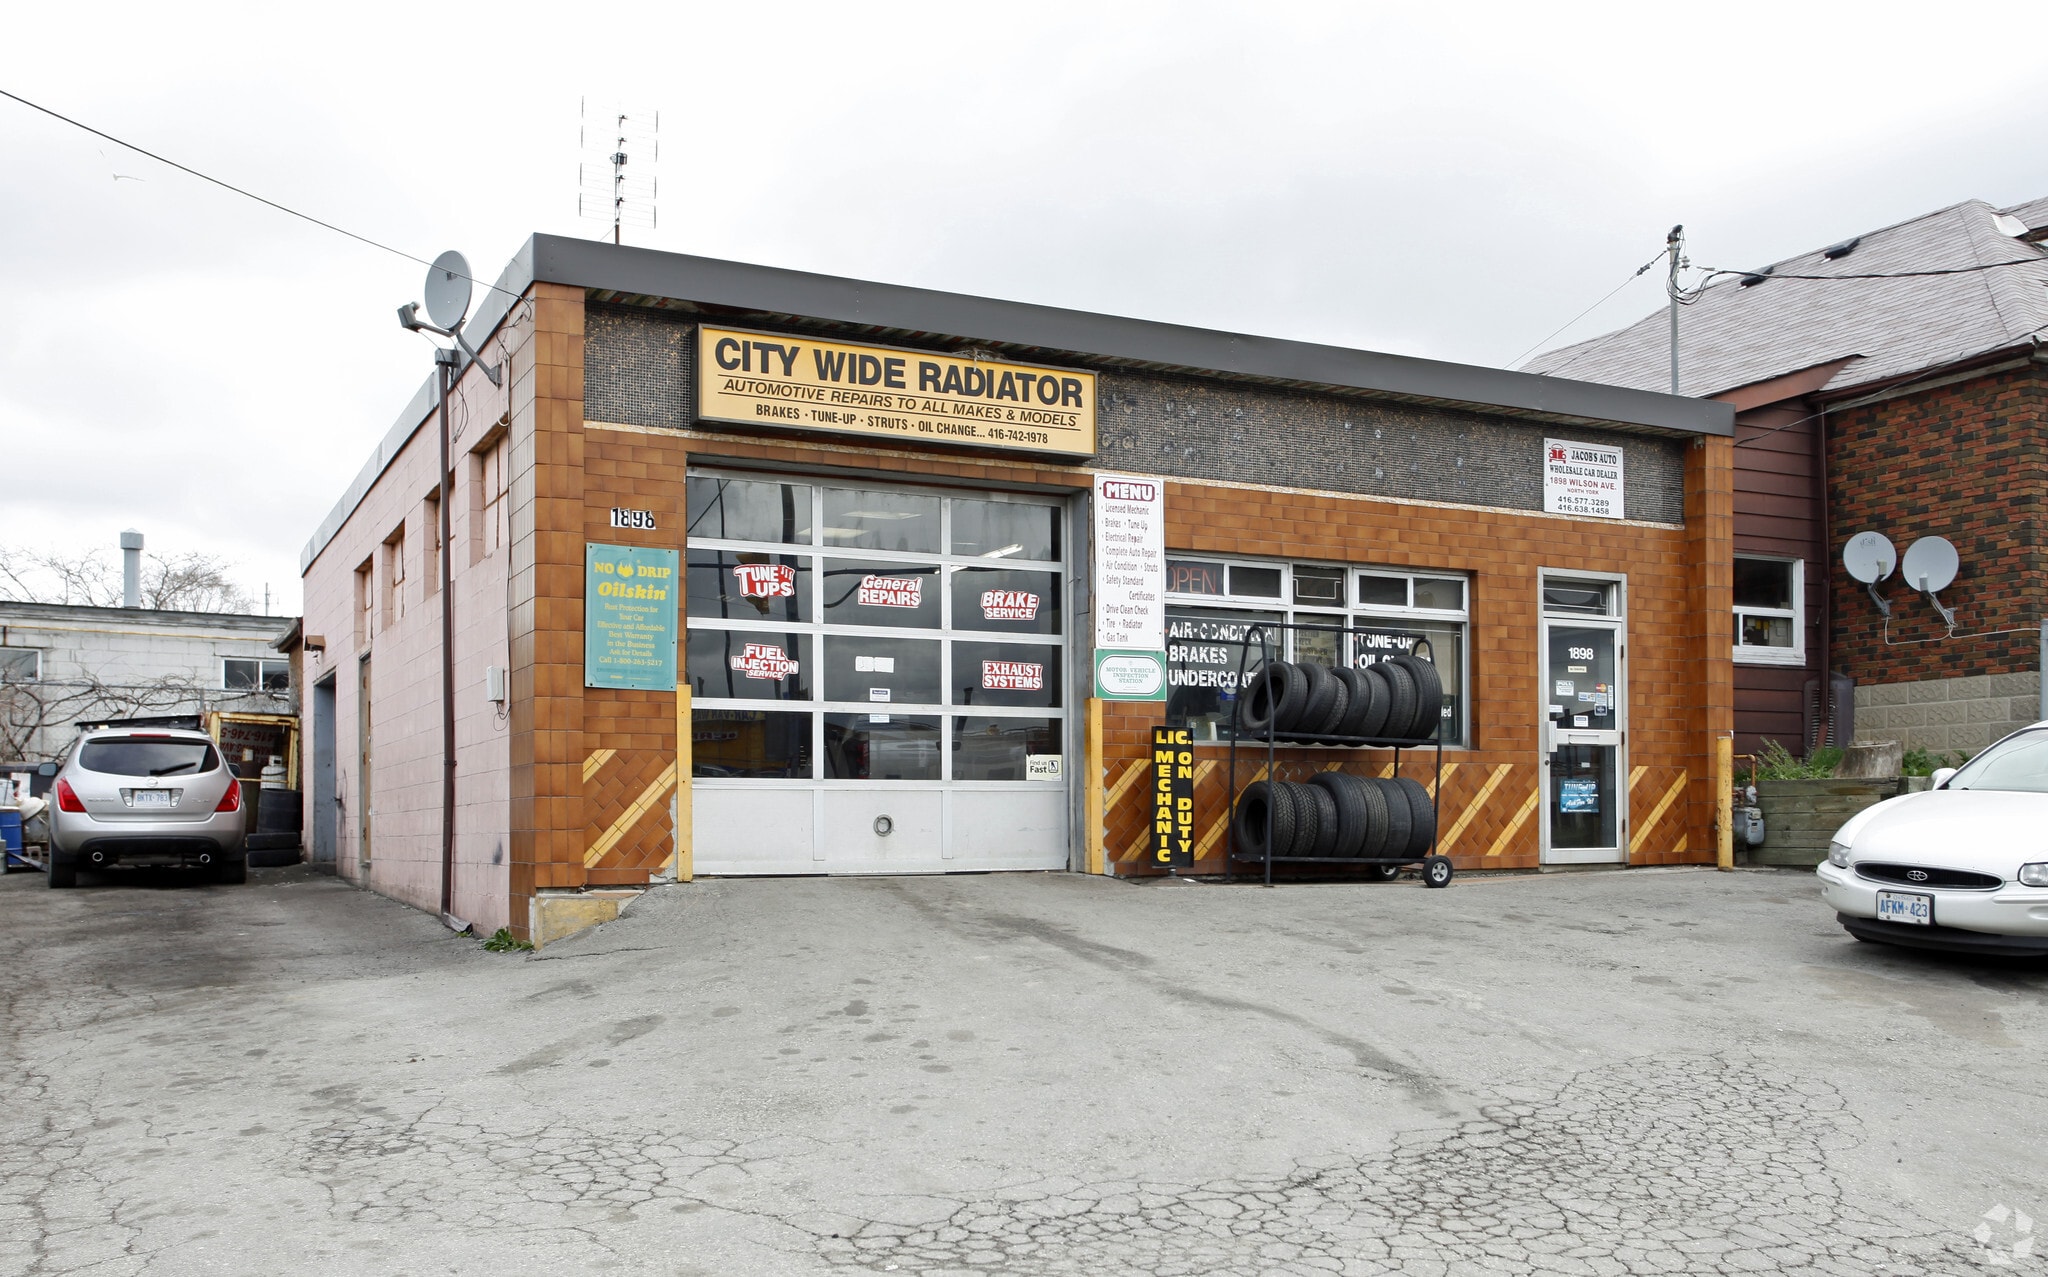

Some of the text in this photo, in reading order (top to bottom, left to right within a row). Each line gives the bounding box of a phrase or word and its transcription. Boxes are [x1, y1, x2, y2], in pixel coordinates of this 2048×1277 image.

[715, 338, 1083, 408] CITY WIDE RADIATOR
[723, 378, 1077, 427] AUTOMOTIVE REPAIRS TO ALL MAKES & MODELS
[756, 404, 1048, 444] BRAKES TUNE-UP STRUTS OIL CHANGE... 416-742-1978
[1600, 453, 1617, 465] AUTO
[1549, 464, 1618, 480] WHOLESALE CAR DEALER
[1549, 476, 1617, 490] 1898 WILSON AVE.
[1106, 482, 1153, 501] MENU
[1105, 502, 1149, 515] Licensed Mechanic
[1558, 495, 1609, 507] 416.577.3289
[1558, 504, 1609, 515] 416.638.1458
[612, 507, 656, 529] 1898
[1105, 517, 1148, 533] Brakes Tune Up
[1105, 531, 1143, 545] Electrical Repair
[1105, 545, 1157, 560] Complete Auto Repair
[594, 562, 671, 578] NO DRIP
[1114, 560, 1137, 571] Condition
[1144, 562, 1158, 572] Struts
[735, 566, 779, 595] TUNE
[862, 575, 921, 591] General
[1106, 574, 1144, 588] Safety Standard
[1167, 566, 1216, 594] OPEN
[597, 581, 666, 600] Oilskin
[755, 581, 792, 597] UPS
[1129, 590, 1155, 601] Certificates
[859, 588, 920, 606] REPAIRS
[982, 591, 1038, 608] BRAKE
[986, 607, 1033, 618] SERVICE
[1106, 603, 1148, 615] Drive Clean Check
[1106, 618, 1143, 629] Tire Radiator
[1106, 632, 1128, 642] Gas Tank
[1358, 633, 1413, 649] TUNE-UP
[746, 646, 785, 661] FUEL
[1169, 645, 1228, 665] BRAKES
[1568, 647, 1594, 660] 1898
[733, 657, 797, 673] INJECTION
[984, 662, 1041, 677] EXHAUST
[748, 669, 784, 678] SERVICE
[984, 674, 1041, 688] SYSTEMS
[1155, 730, 1192, 744] LIC.
[1177, 752, 1192, 778] ON
[1155, 750, 1174, 863] MECHANIC
[1177, 798, 1192, 853] DUTY
[1910, 902, 1928, 917] 423
